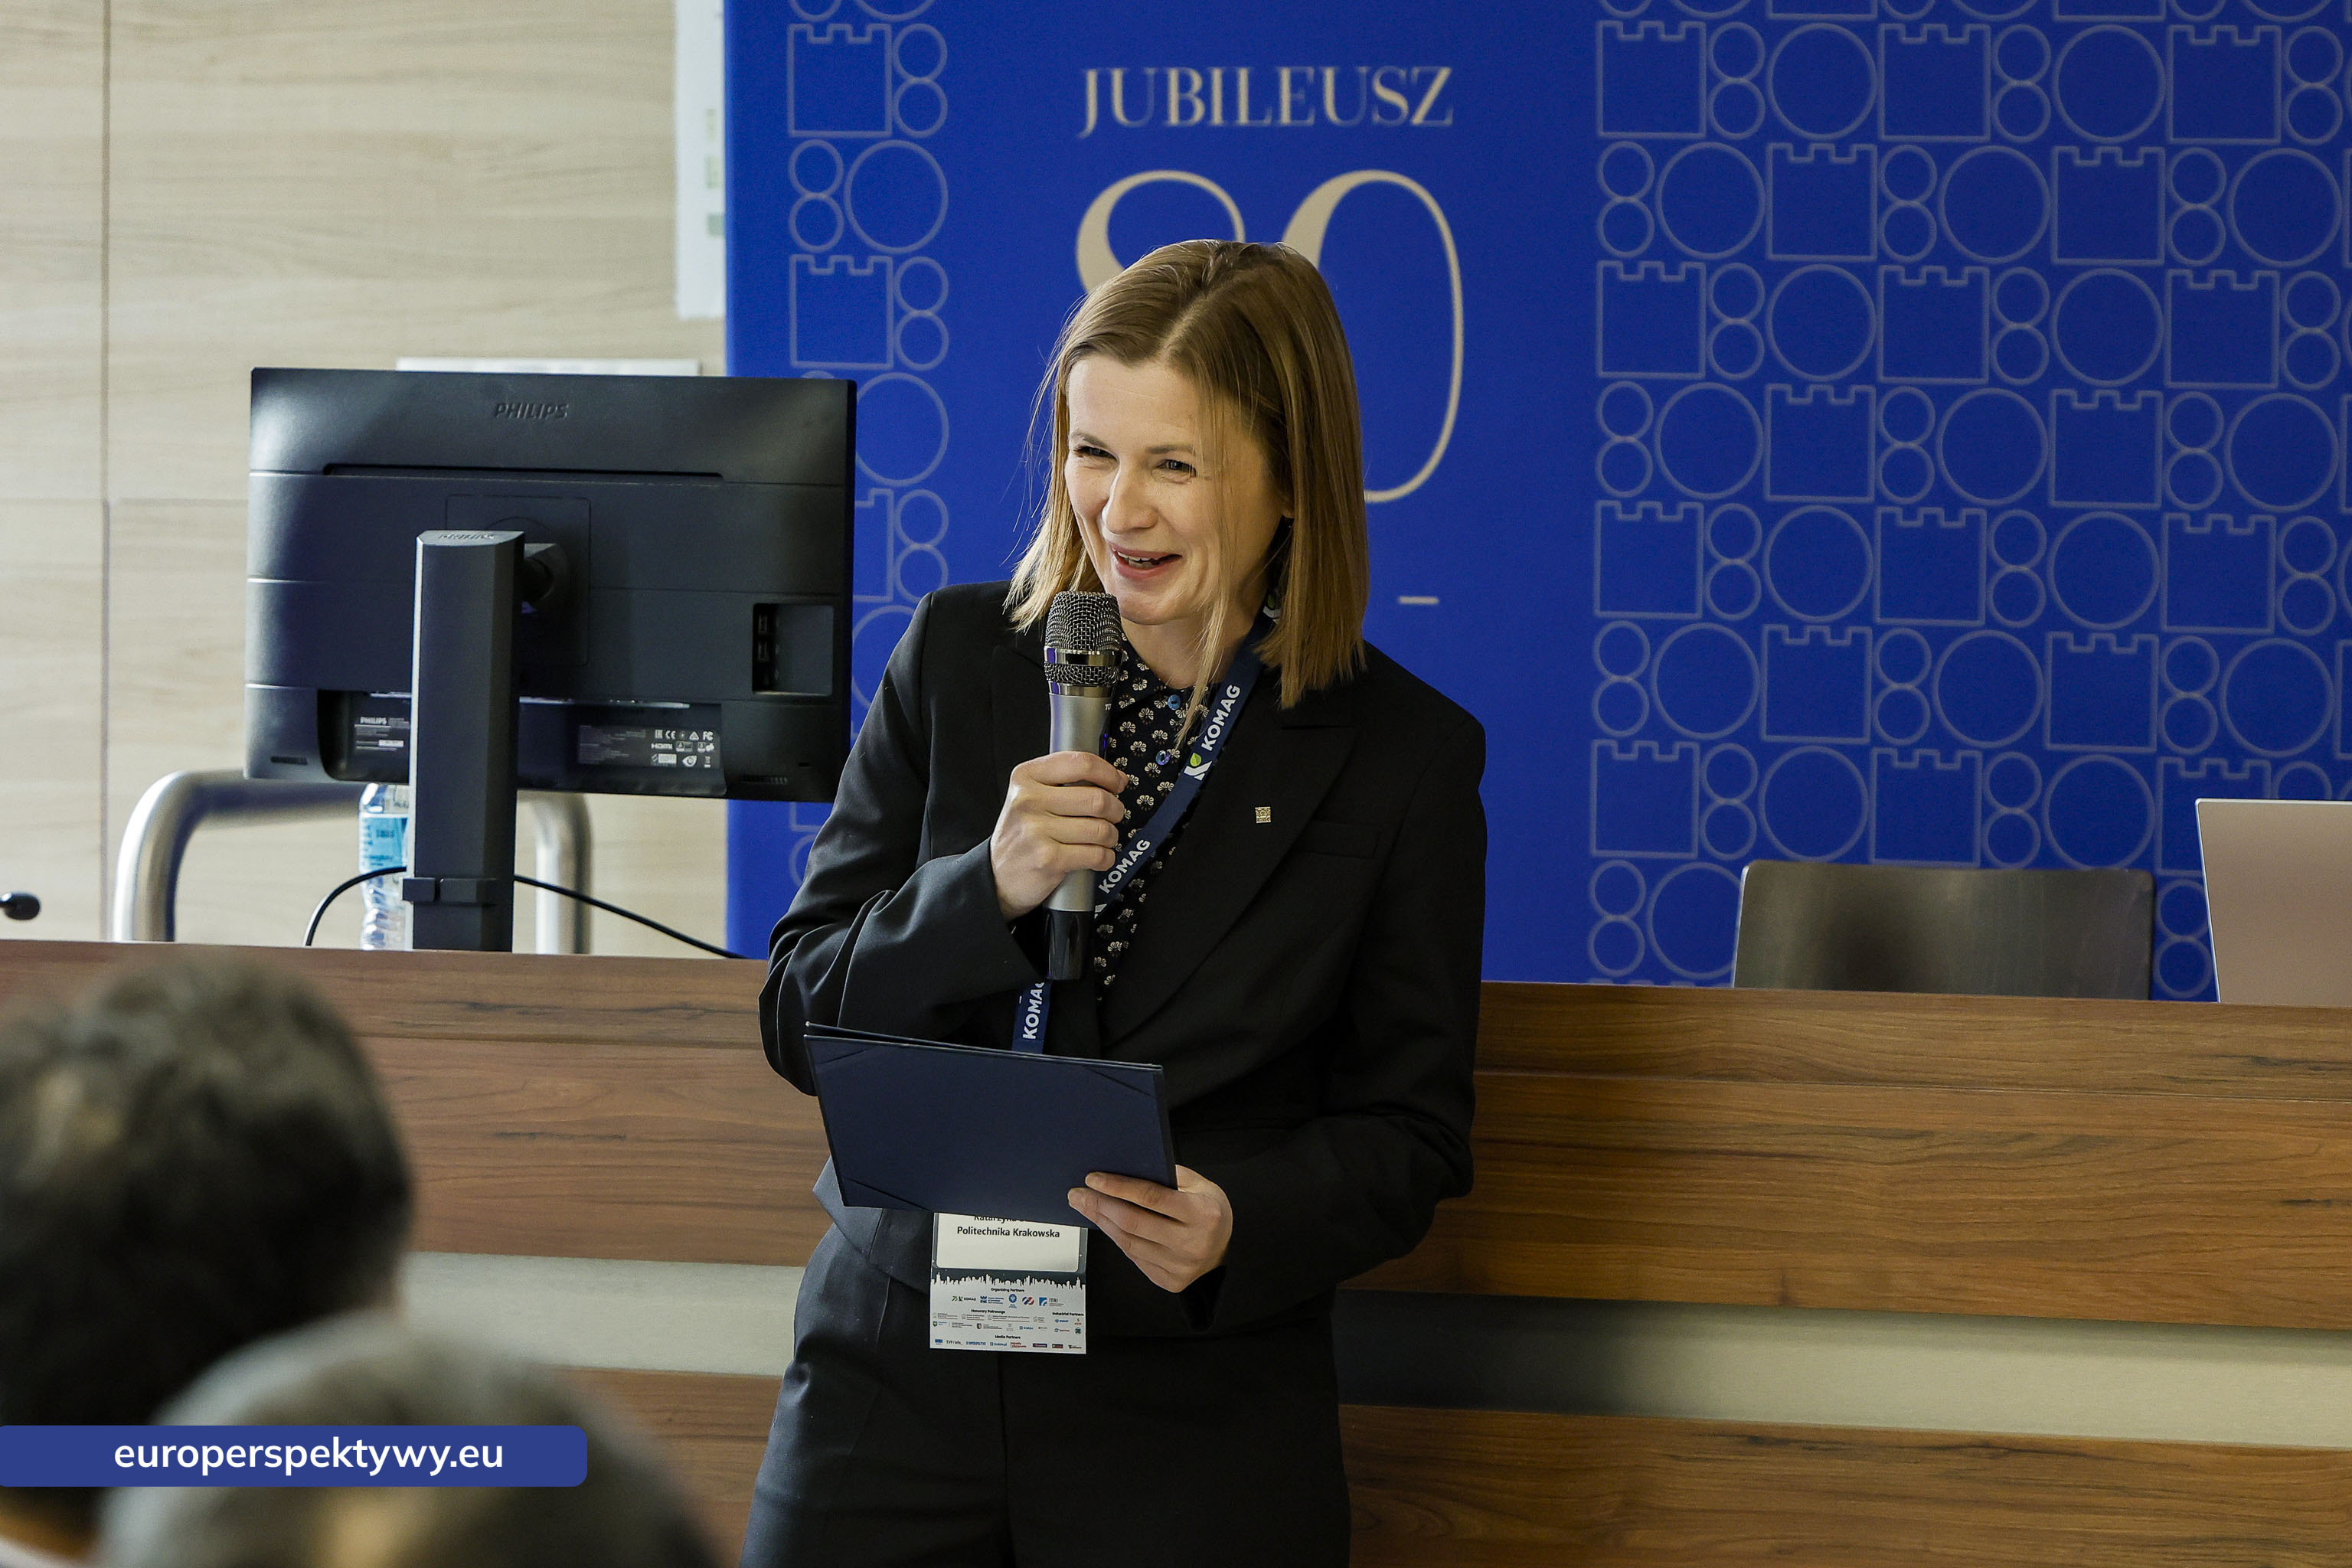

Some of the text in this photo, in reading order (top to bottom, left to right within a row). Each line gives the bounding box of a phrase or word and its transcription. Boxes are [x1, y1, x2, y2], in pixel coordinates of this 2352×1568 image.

[1079, 66, 1454, 139] JUBILEUSZ
[495, 403, 569, 420] PHILIPS
[360, 717, 387, 725] PHILIPS
[1200, 684, 1240, 752] KOMAG
[1098, 838, 1151, 894] KOMAG
[957, 1227, 1060, 1237] Politechnika Krakowska
